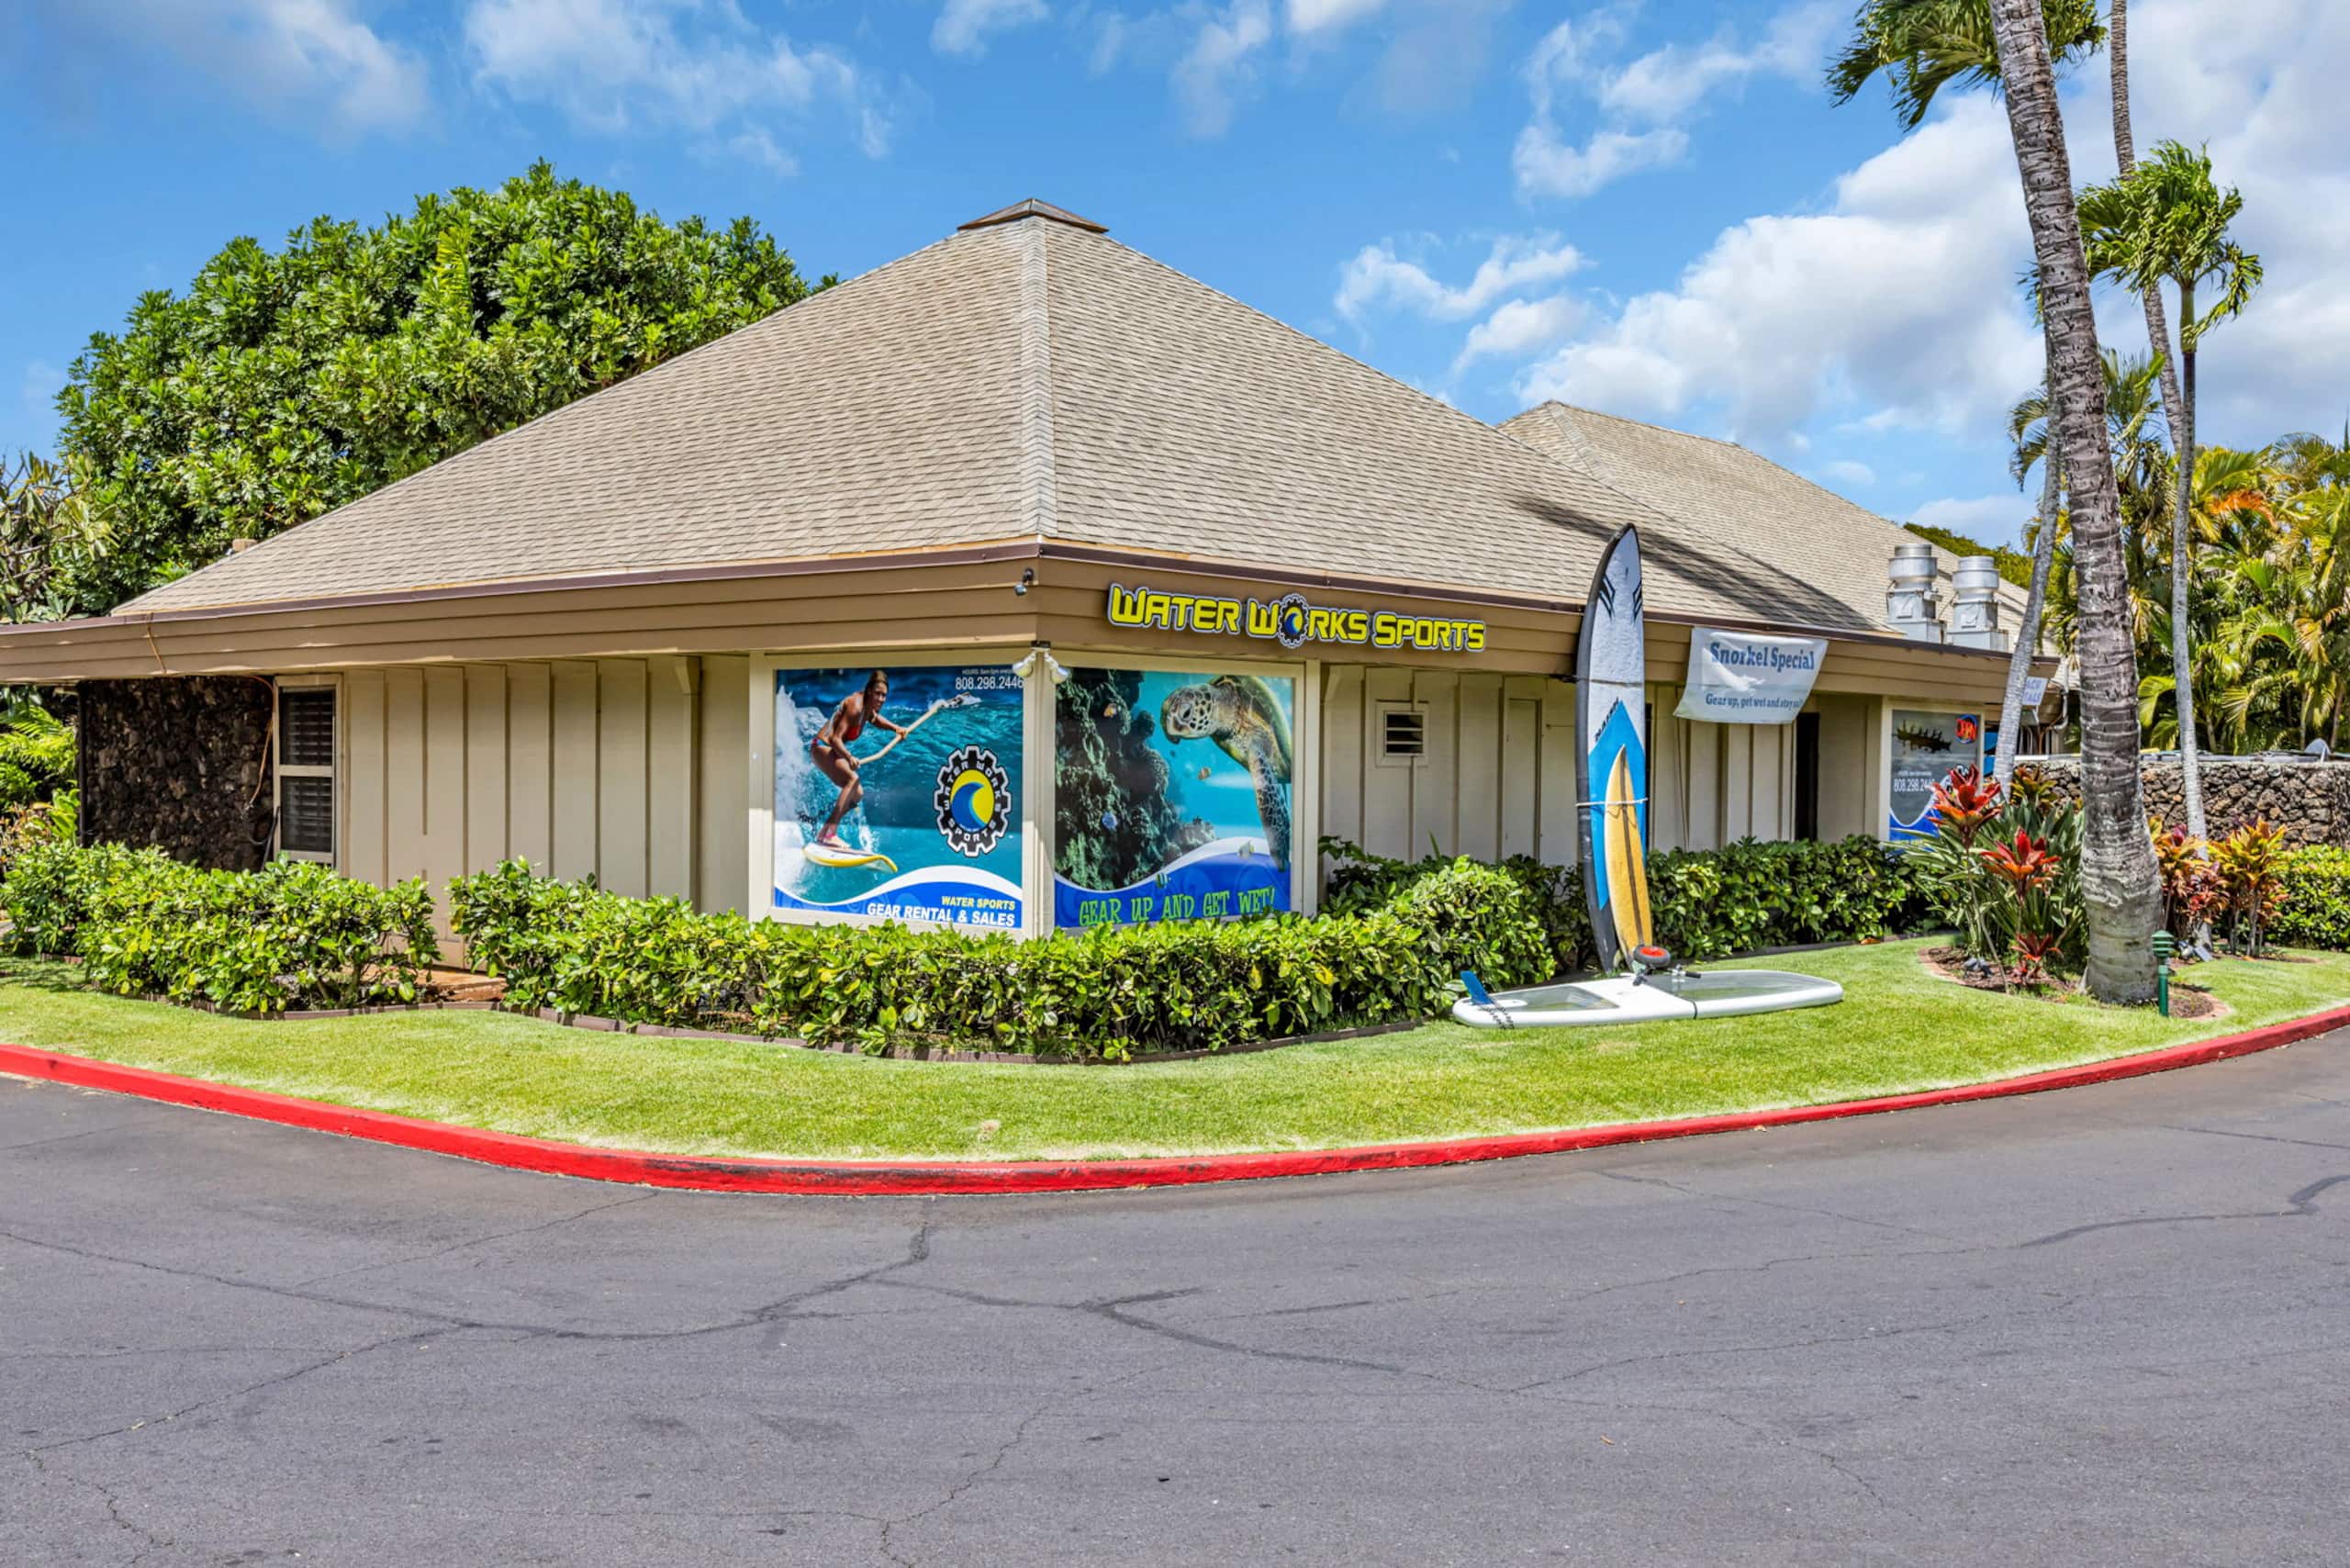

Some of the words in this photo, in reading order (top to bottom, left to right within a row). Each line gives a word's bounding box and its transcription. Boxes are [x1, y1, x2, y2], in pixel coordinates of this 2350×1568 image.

[1109, 585, 1242, 633] WATER
[1374, 612, 1486, 651] SPORTS
[1710, 641, 1768, 666] Snorkel
[1771, 645, 1815, 672] Special
[956, 676, 1024, 690] 808.298.2446
[867, 902, 901, 917] GEAR
[904, 905, 953, 922] RENTAL
[957, 910, 968, 923] &
[971, 911, 1015, 927] SALES
[942, 896, 974, 908] WATER
[977, 898, 1015, 911] SPORTS
[1079, 898, 1123, 926] GEAR
[1131, 897, 1154, 922] UP
[1162, 893, 1195, 920] AND
[1203, 890, 1230, 917] GET
[1238, 887, 1275, 914] WET!
